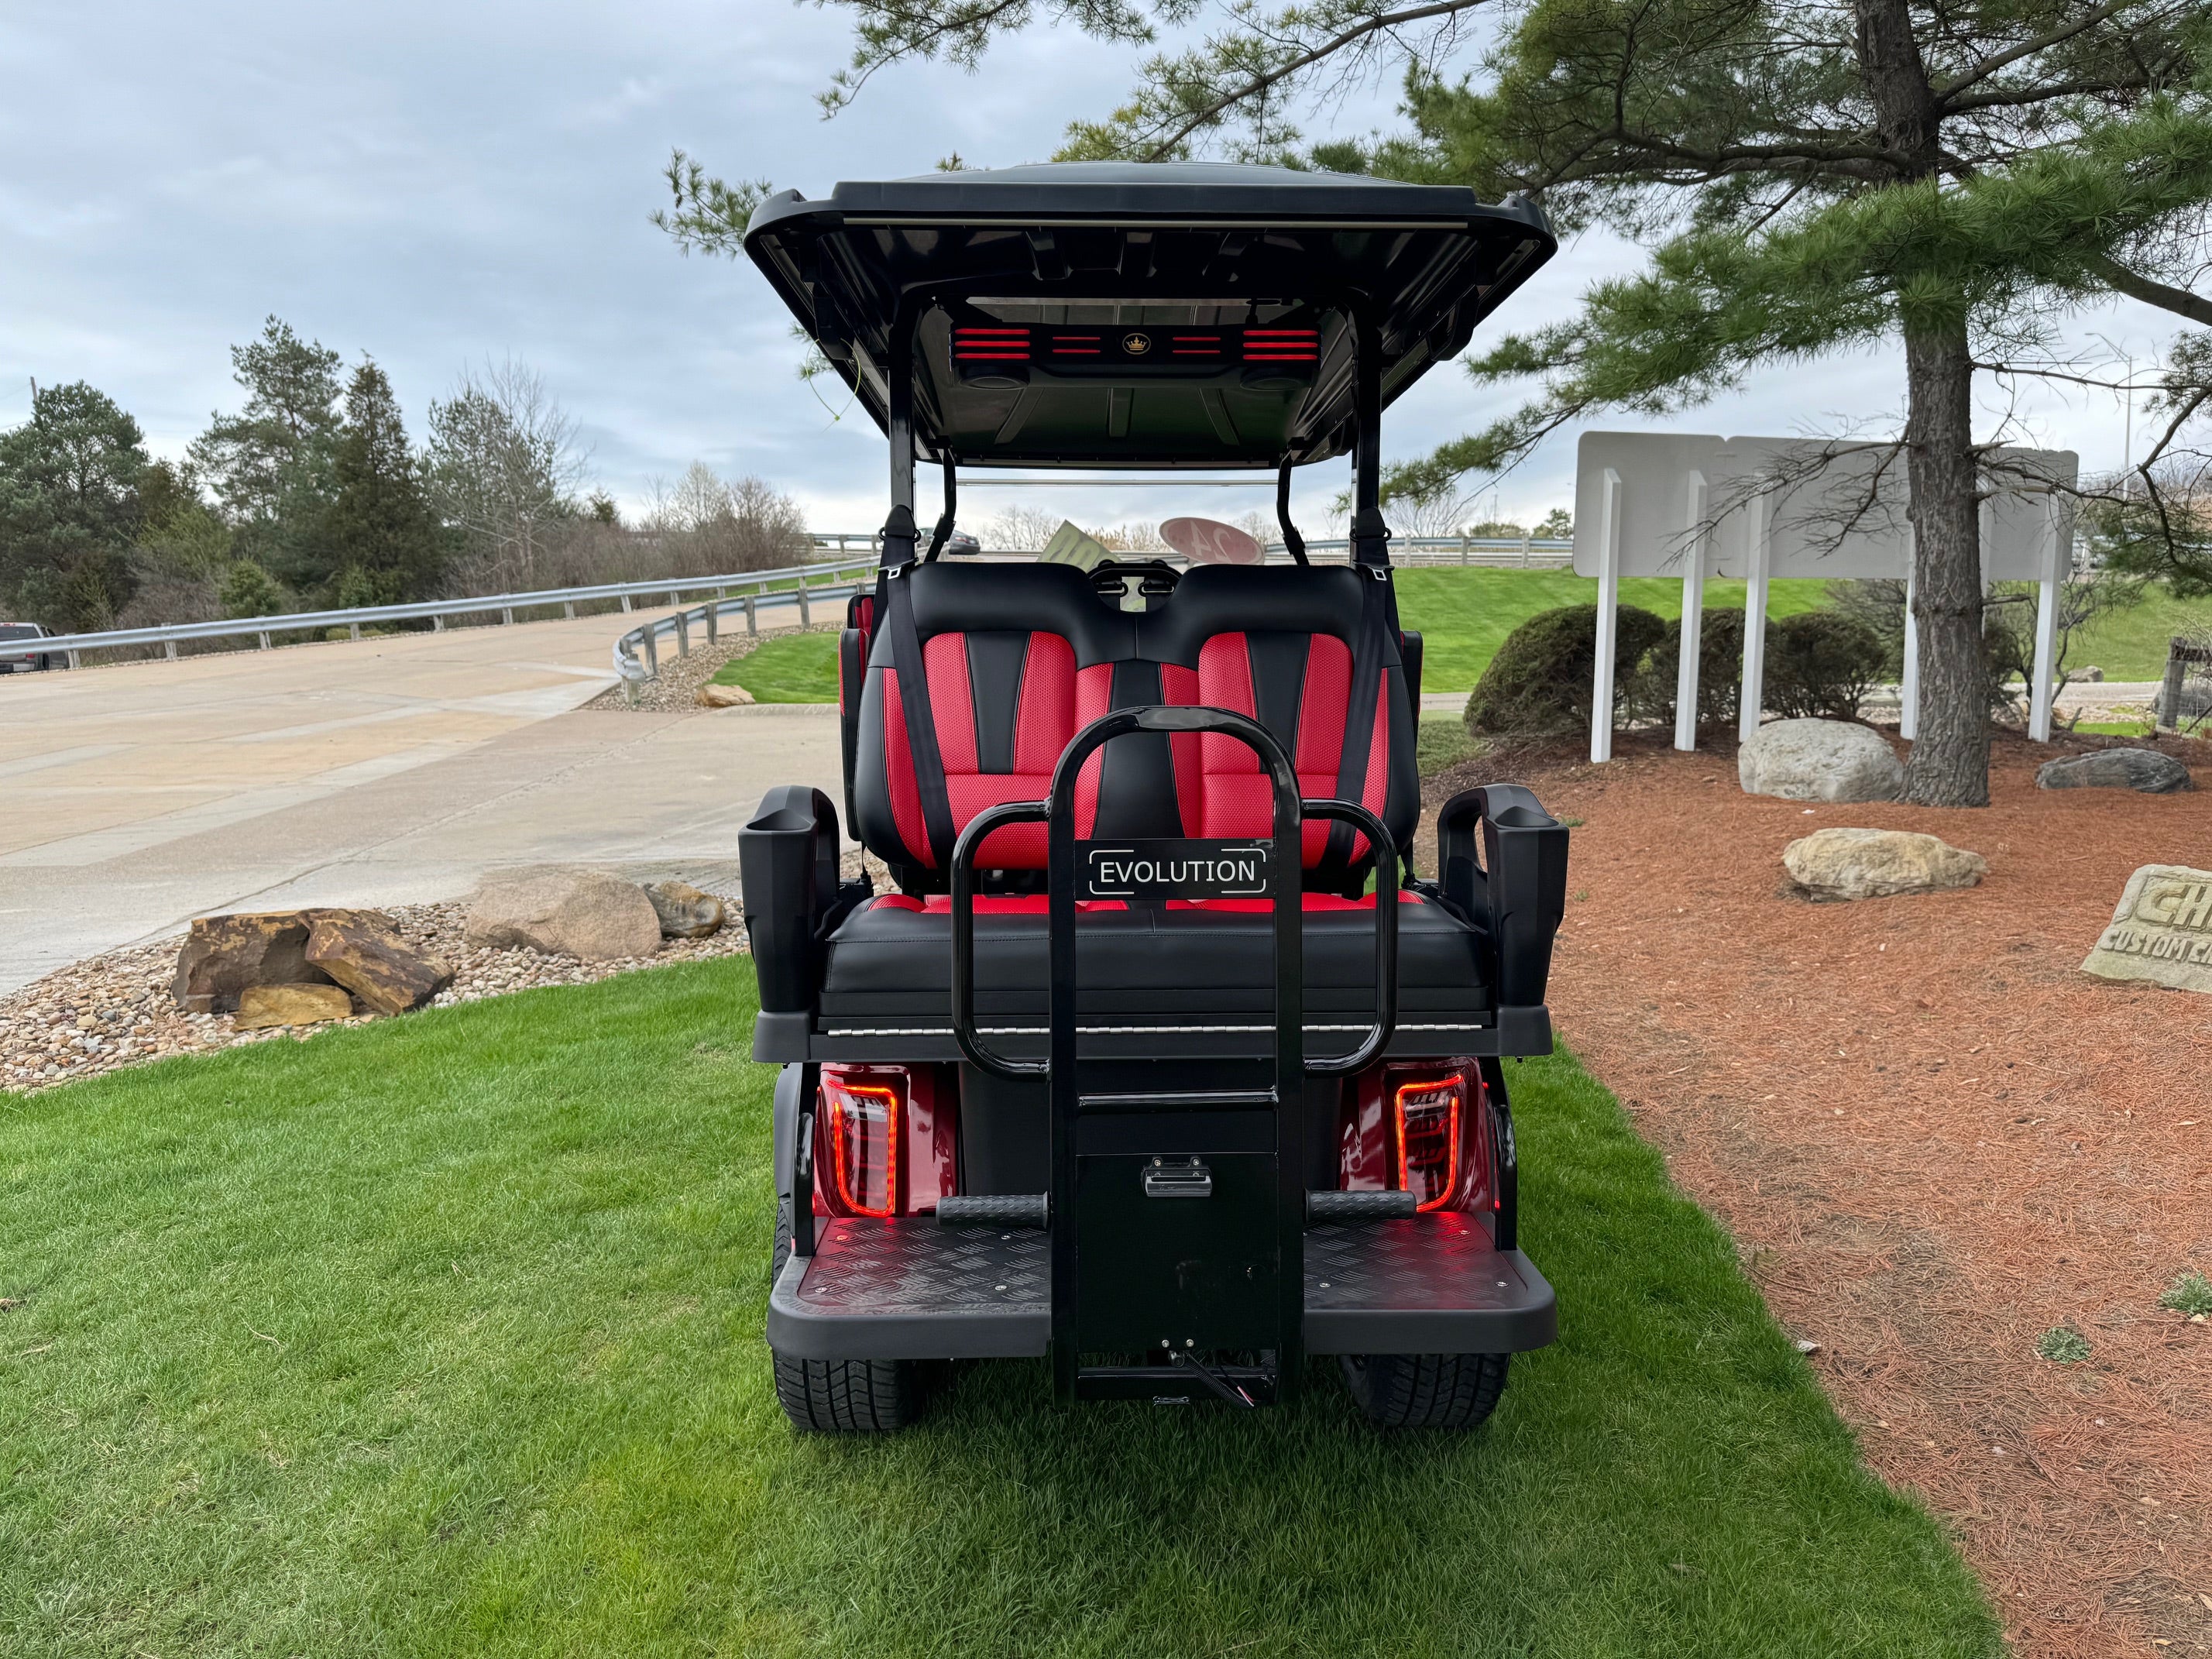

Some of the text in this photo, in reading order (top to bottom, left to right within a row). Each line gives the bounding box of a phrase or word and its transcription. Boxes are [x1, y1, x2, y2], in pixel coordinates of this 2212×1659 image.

[1100, 860, 1255, 883] EVOLUTION
[2136, 881, 2212, 930] CH
[2100, 929, 2190, 962] CUSTOM
